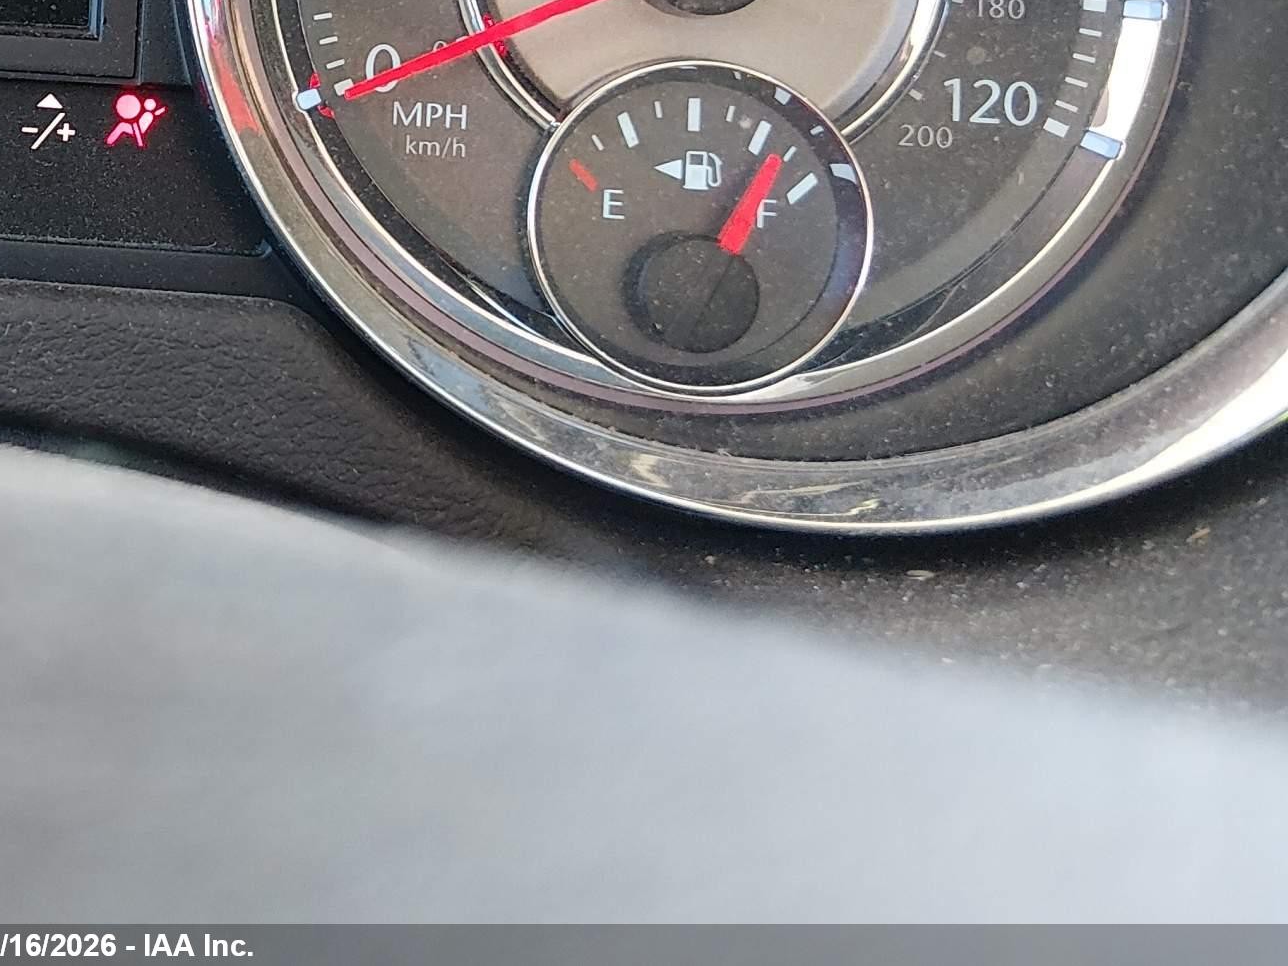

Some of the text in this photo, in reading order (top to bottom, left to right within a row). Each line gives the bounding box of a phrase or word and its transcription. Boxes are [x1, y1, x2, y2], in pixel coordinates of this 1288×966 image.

[365, 43, 402, 93] 0
[393, 101, 467, 131] MPH
[942, 78, 1040, 128] 120
[405, 136, 467, 159] km/h
[898, 124, 954, 150] 200
[603, 189, 624, 219] E
[756, 199, 778, 228] F
